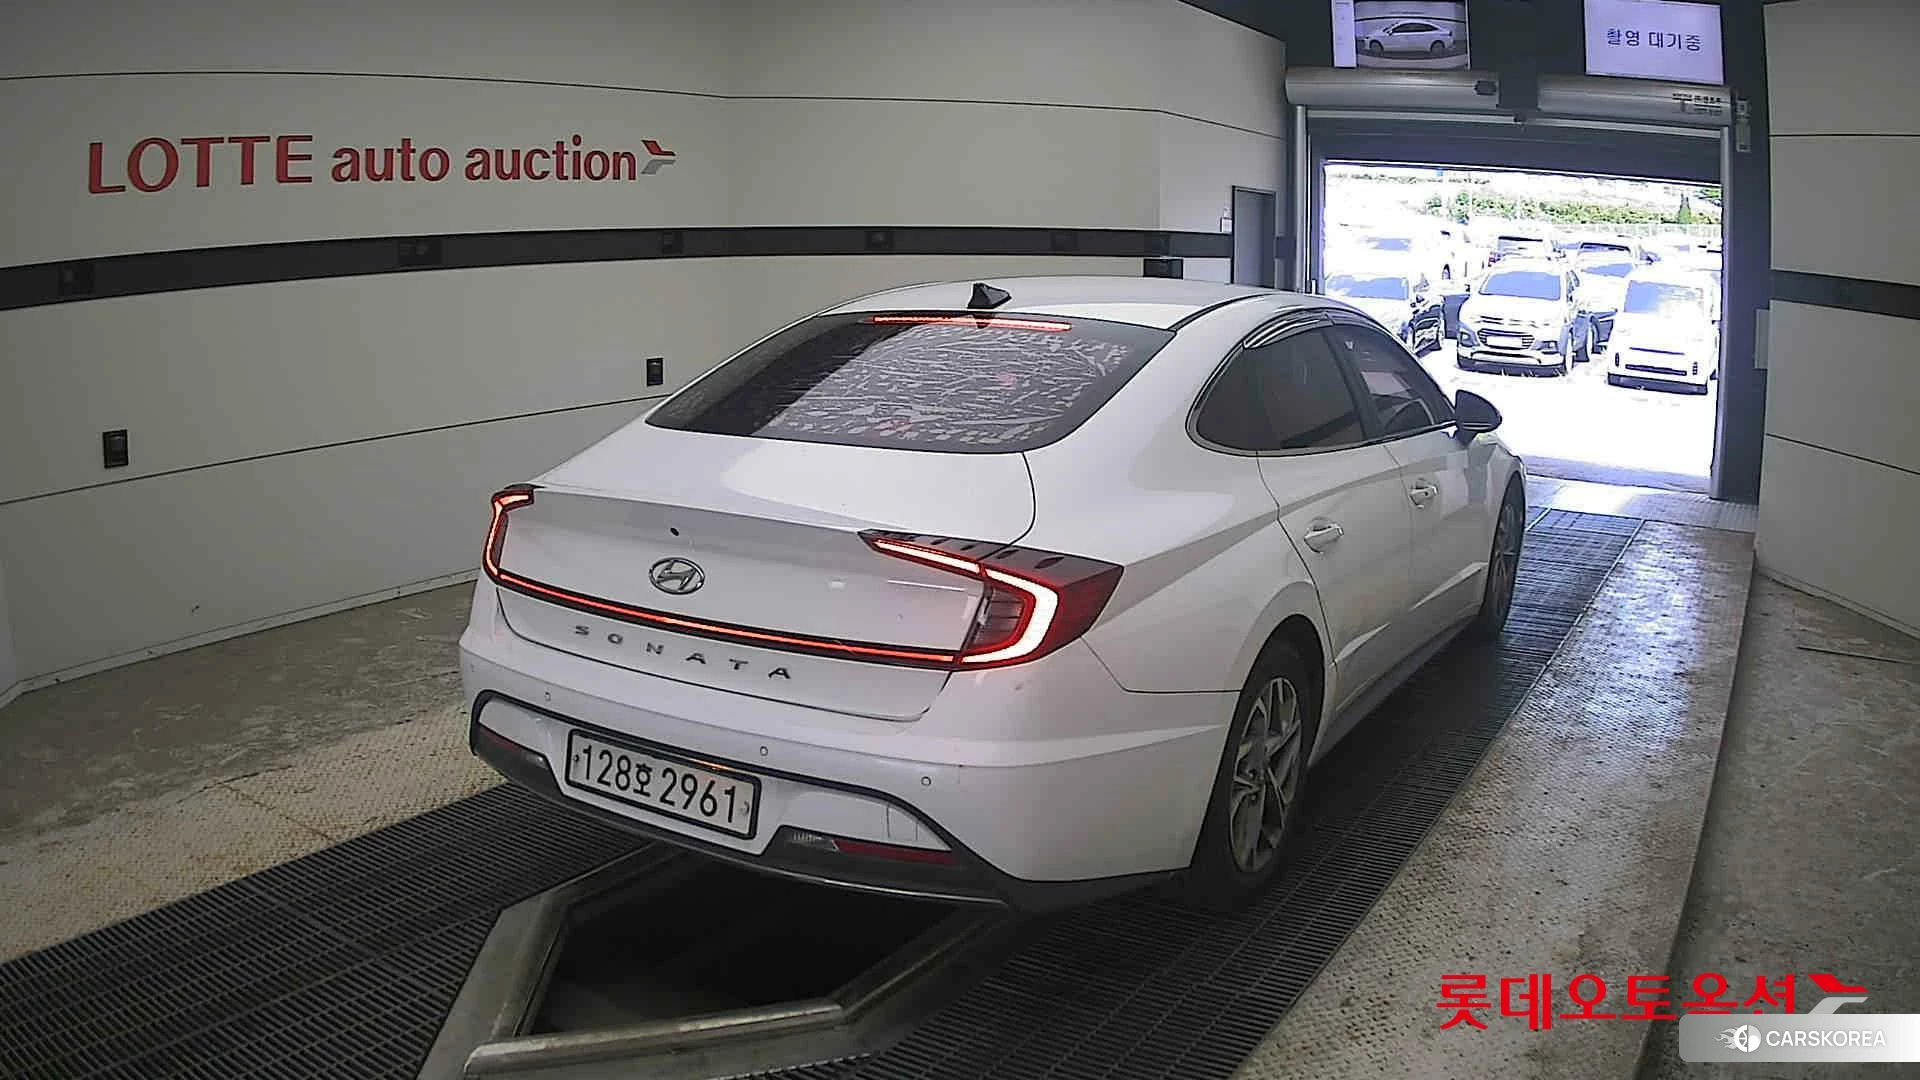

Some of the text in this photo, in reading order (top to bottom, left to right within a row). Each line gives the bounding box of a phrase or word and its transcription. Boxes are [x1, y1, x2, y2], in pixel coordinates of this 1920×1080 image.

[1607, 28, 1701, 52] 촬영 대기중
[88, 134, 637, 194] LOTTE auto auction
[575, 624, 792, 680] SONATA
